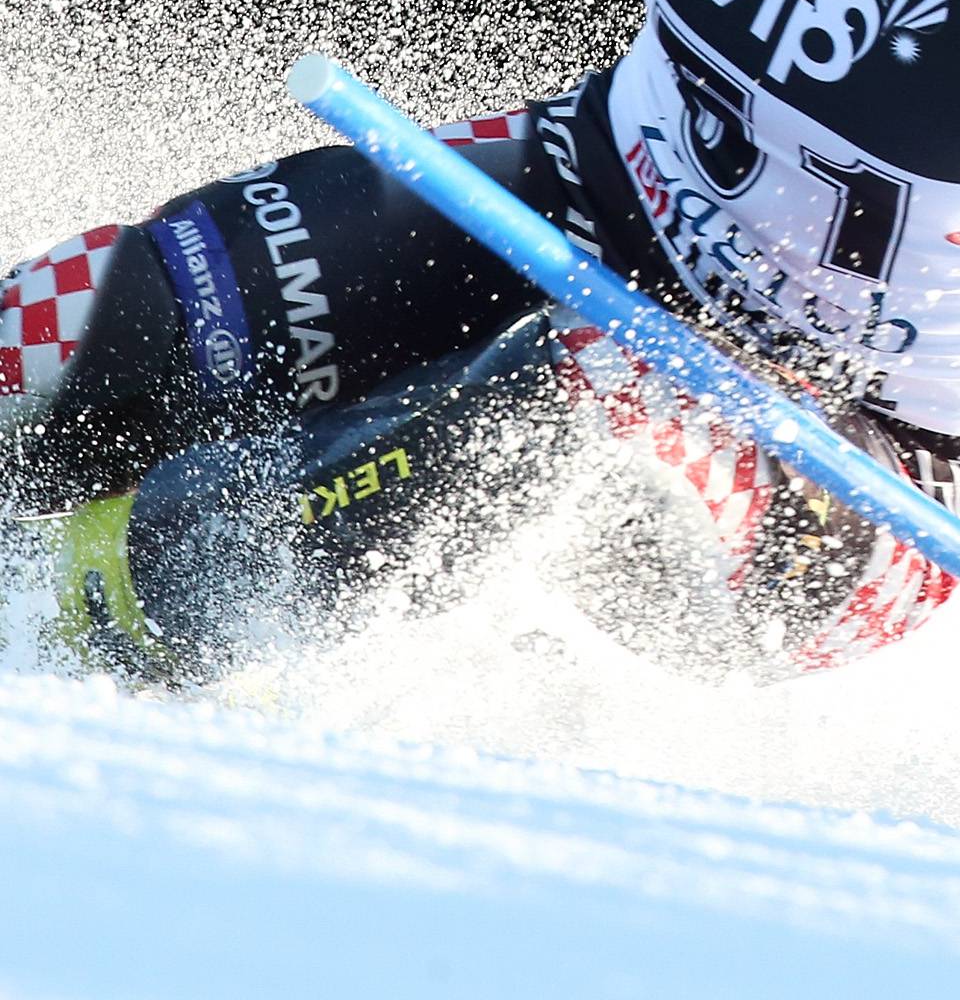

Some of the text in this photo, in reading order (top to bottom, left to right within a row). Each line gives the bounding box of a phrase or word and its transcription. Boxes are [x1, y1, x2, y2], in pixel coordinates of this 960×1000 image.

[168, 219, 224, 321] Allianz
[243, 181, 340, 409] COLMAR
[299, 448, 412, 525] LEKI
